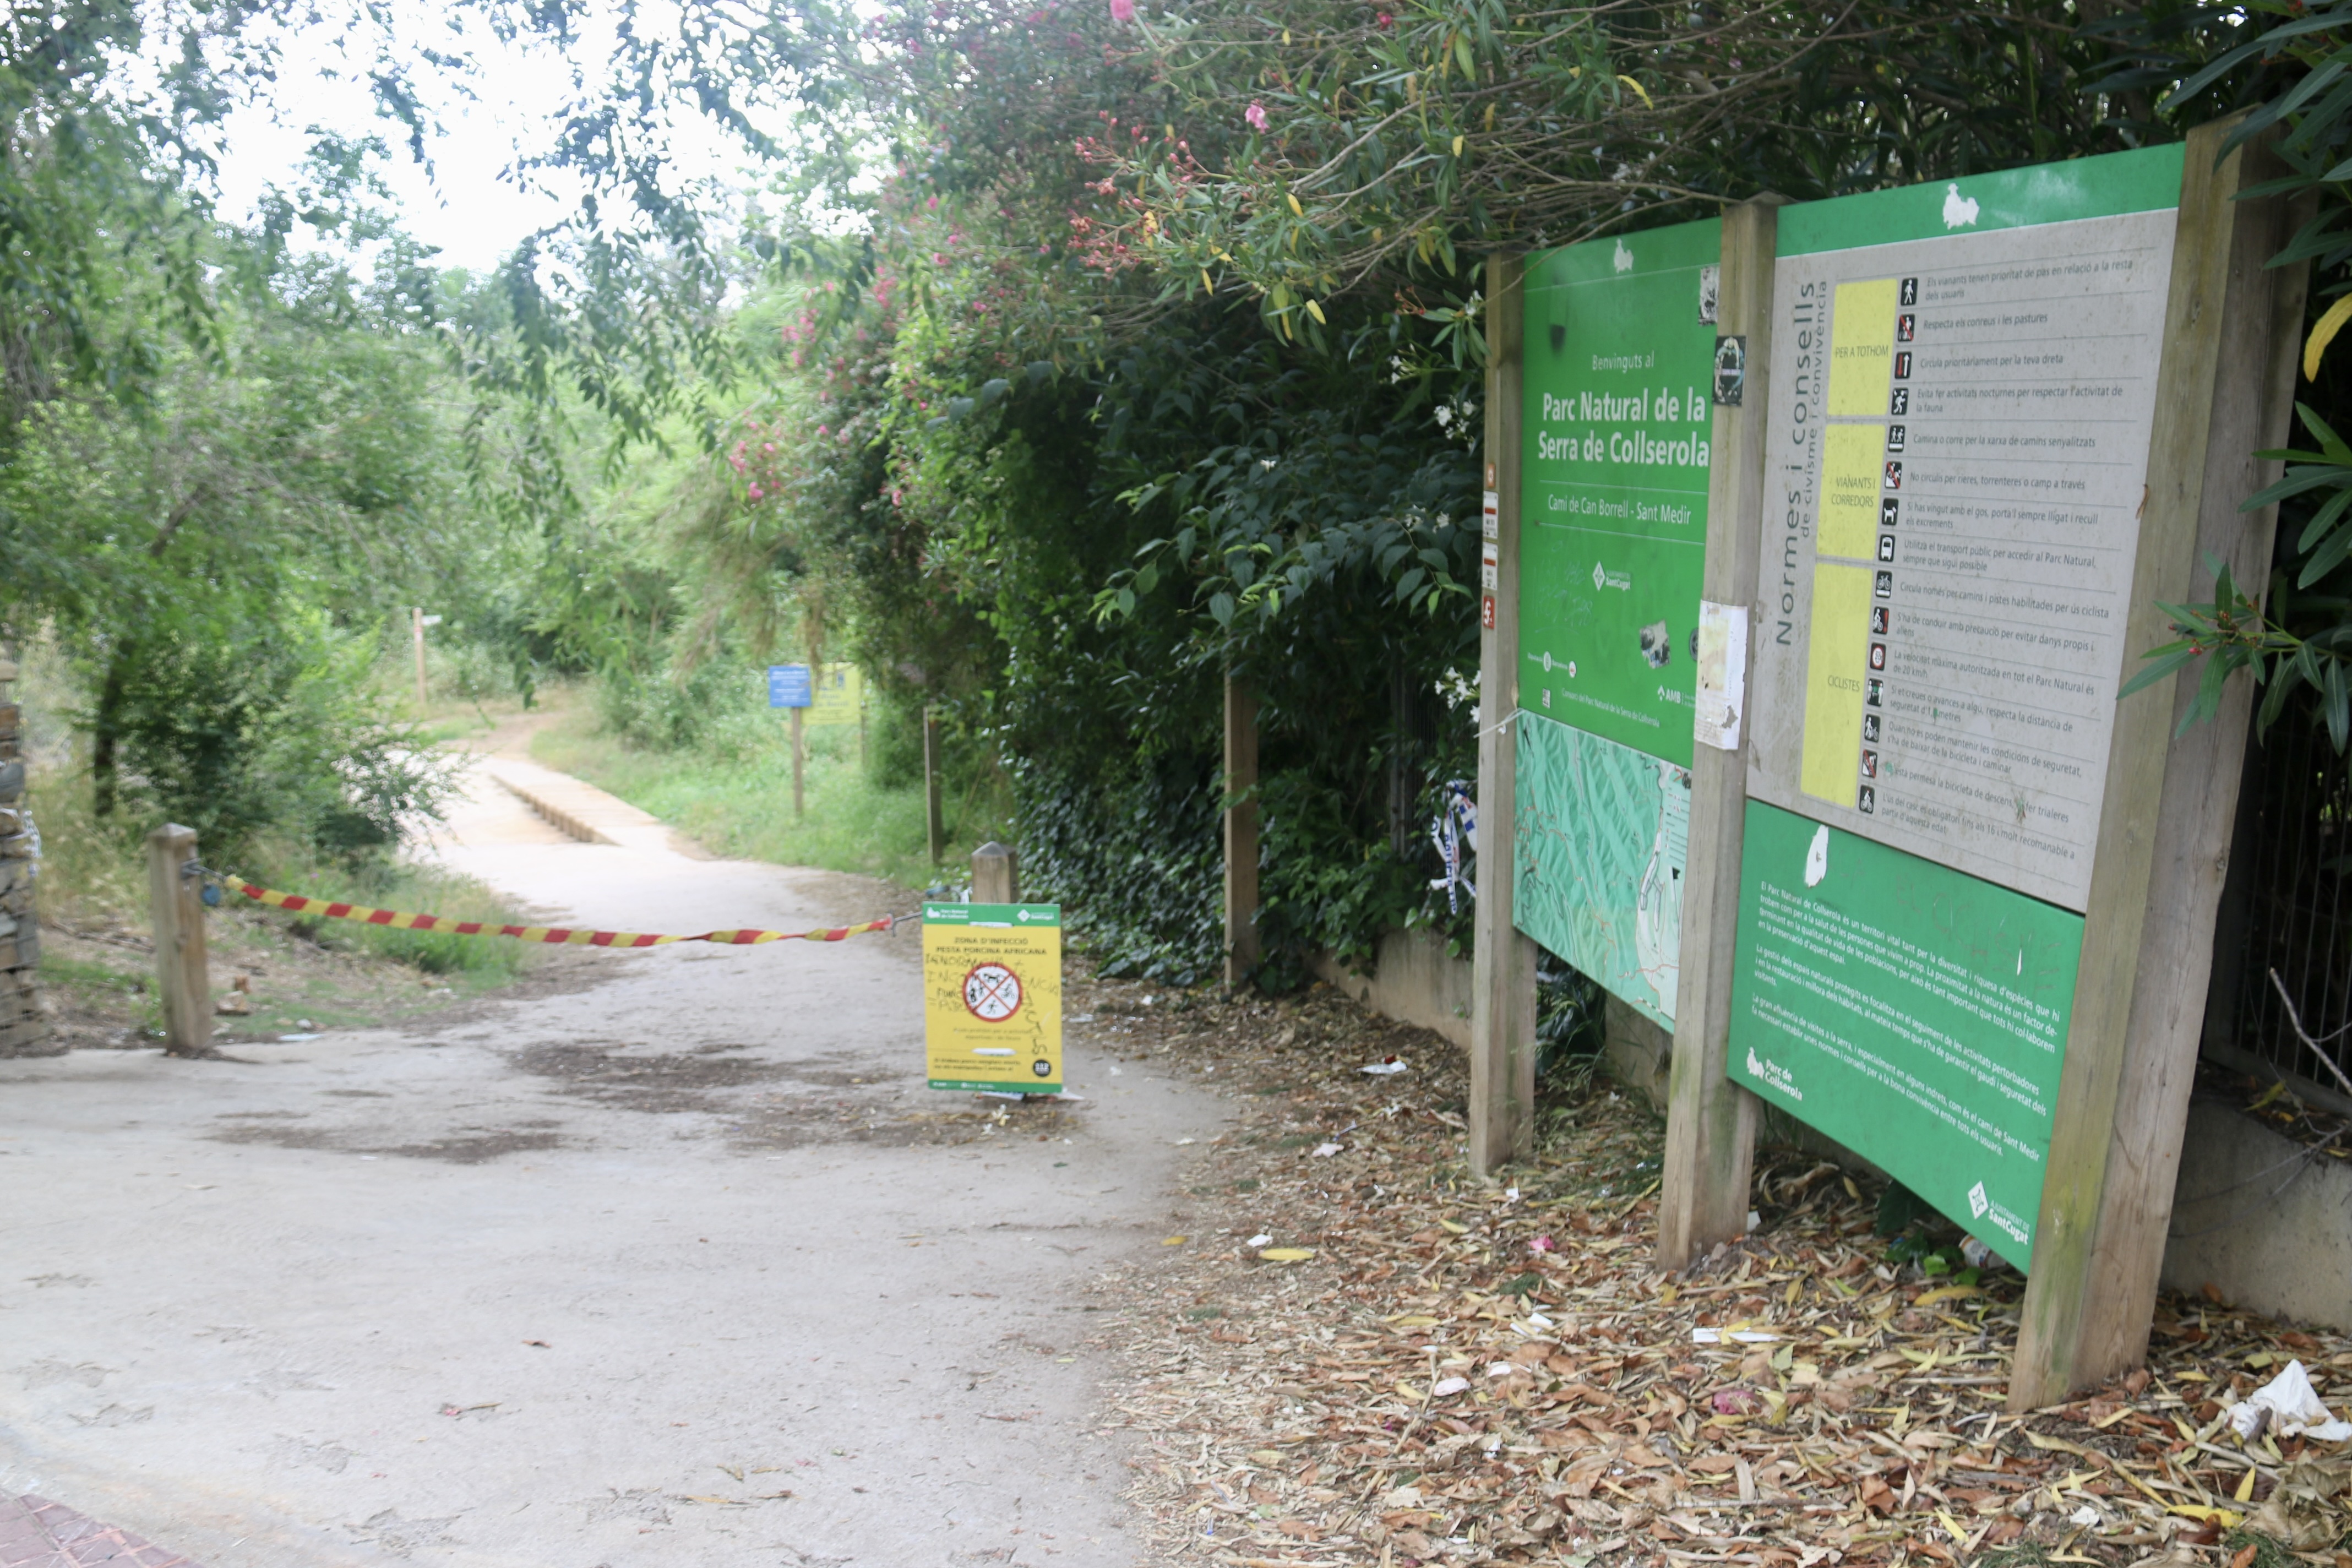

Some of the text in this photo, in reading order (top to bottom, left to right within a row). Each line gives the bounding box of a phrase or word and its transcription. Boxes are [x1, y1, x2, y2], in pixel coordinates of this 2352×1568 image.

[1968, 273, 1990, 283] tenen
[1990, 268, 2023, 282] prioritat
[2023, 268, 2035, 278] de
[2035, 268, 2050, 279] pas
[2051, 266, 2062, 275] en
[2093, 263, 2099, 272] a
[2101, 260, 2109, 271] la
[2111, 260, 2133, 269] resta
[1923, 319, 1954, 330] Respecta
[1954, 318, 1966, 328] els
[1966, 317, 1996, 326] conreus
[2001, 314, 2012, 325] les
[2013, 313, 2048, 326] pastures
[1812, 281, 1827, 405] convivència
[1835, 345, 1888, 358] PER A TOTHOM
[1592, 350, 1655, 374] Benvinguts al
[1919, 358, 1943, 368] Circula
[1999, 357, 2013, 367] per
[2013, 354, 2022, 364] la
[2023, 355, 2040, 364] teva
[2041, 353, 2064, 364] dreta
[1543, 386, 1706, 422] Parc Natural de la
[1538, 430, 1710, 467] Serra de Collserola
[1913, 433, 2095, 449] Camina o corre per la xarxa de camins senyalitzats
[1776, 491, 1801, 645] Normes
[1793, 282, 1814, 445] consells
[1803, 428, 1817, 504] civisme
[1836, 476, 1876, 489] VIANANTS I
[1909, 471, 1920, 481] No
[1943, 475, 1956, 484] per
[1980, 475, 2022, 486] torrenteres
[2023, 478, 2029, 487] o
[2030, 479, 2052, 490] camp
[2052, 480, 2059, 488] a
[1548, 493, 1568, 511] Camí
[1569, 496, 1579, 513] de
[1581, 497, 1597, 514] Can
[1599, 498, 1629, 518] Borrell
[1636, 502, 1658, 521] Sant
[1660, 504, 1692, 525] Medir
[1831, 493, 1874, 507] CORREDORS
[1907, 501, 1913, 510] Si
[1914, 502, 1925, 511] has
[1926, 505, 1948, 515] vingut
[1949, 504, 1966, 515] amb
[1966, 505, 1974, 515] el
[2017, 511, 2046, 522] sempre
[2047, 510, 2068, 524] lligat
[2074, 513, 2098, 524] recull
[1801, 513, 1811, 538] de
[1606, 576, 1630, 591] SantCugat
[1828, 674, 1860, 692] CICLISTES
[1561, 688, 1578, 701] Consorci
[1586, 694, 1594, 705] Parc
[1594, 698, 1610, 711] Natural
[1610, 703, 1615, 712] de
[1616, 705, 1620, 714] la
[1620, 706, 1631, 719] Serra
[1632, 709, 1637, 720] de
[1638, 712, 1660, 728] Collserola
[1665, 689, 1681, 704] AMB
[1888, 721, 1905, 733] Quan
[1924, 731, 1946, 742] poden
[1947, 737, 1979, 750] mantenir
[1979, 742, 1989, 754] les
[1991, 748, 2029, 764] condicions
[2030, 754, 2041, 766] de
[1760, 880, 1767, 890] El
[1767, 883, 1780, 895] Parc
[1781, 889, 1802, 905] Natural
[1803, 899, 1811, 908] de
[1812, 902, 1841, 921] Collserola
[1850, 919, 1860, 929] un
[1860, 923, 1885, 939] territori
[1886, 935, 1901, 946] vital
[1902, 940, 1915, 953] tant
[1916, 948, 1928, 959] per
[1929, 951, 1936, 963] la
[1937, 956, 1967, 977] diversitat
[1973, 974, 1997, 992] riquesa
[2034, 1004, 2050, 1017] que
[2051, 1008, 2060, 1022] hi
[1756, 943, 1763, 953] La
[1780, 955, 1792, 966] dels
[1792, 961, 1810, 975] espais
[1810, 970, 1834, 986] naturals
[1834, 981, 1861, 999] protegits
[1861, 994, 1869, 1003] es
[1869, 995, 1896, 1016] focalitza
[1895, 1011, 1904, 1020] en
[1904, 1014, 1912, 1023] el
[1911, 1019, 1943, 1041] seguiment
[1943, 1035, 1953, 1047] de
[1953, 1038, 1962, 1052] les
[1962, 1046, 1991, 1068] activitats
[1991, 1062, 2039, 1096] pertorbadores
[1766, 1058, 1793, 1083] Parc de
[1765, 1071, 1803, 1101] Collserola
[1989, 1207, 2028, 1245] SantCugat
